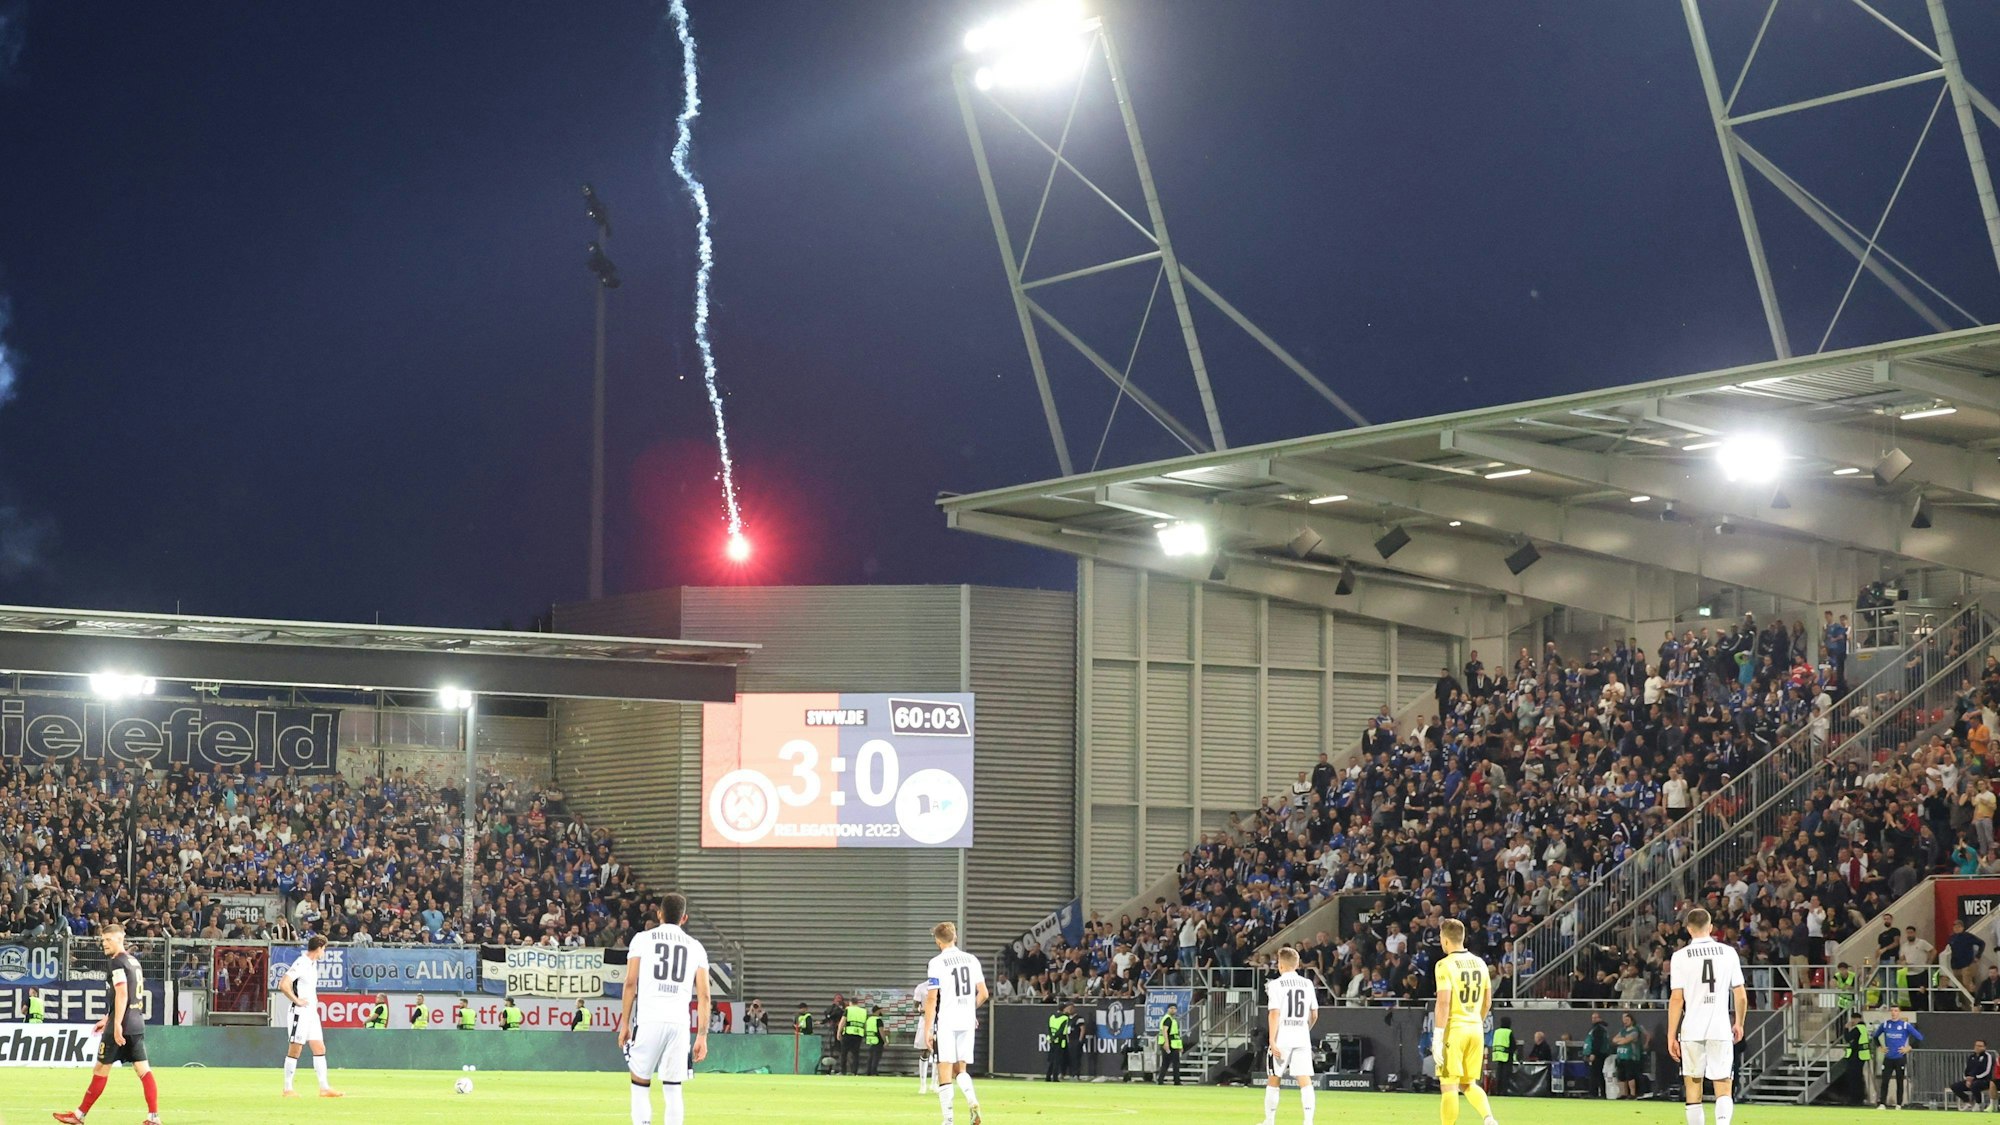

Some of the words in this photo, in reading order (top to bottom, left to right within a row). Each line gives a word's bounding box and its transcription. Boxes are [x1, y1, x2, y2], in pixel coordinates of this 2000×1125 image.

[894, 707, 961, 729] 60:03
[774, 823, 863, 837] RELEGATION
[865, 825, 900, 837] 2023
[1964, 900, 1992, 915] WEST
[31, 947, 58, 979] 05
[351, 963, 399, 982] copa
[405, 960, 474, 980] cALMa
[508, 951, 602, 970] SUPPORTERS
[653, 943, 688, 983] 30
[508, 973, 601, 993] BIELEFELD
[951, 965, 971, 997] 19
[1701, 958, 1716, 993] 4
[1459, 970, 1482, 1004] 33
[1146, 1004, 1164, 1016] Fans
[1286, 988, 1305, 1018] 16
[405, 1004, 444, 1024] Te
[548, 1006, 622, 1031] Faily
[1328, 1080, 1369, 1088] RELEGATION
